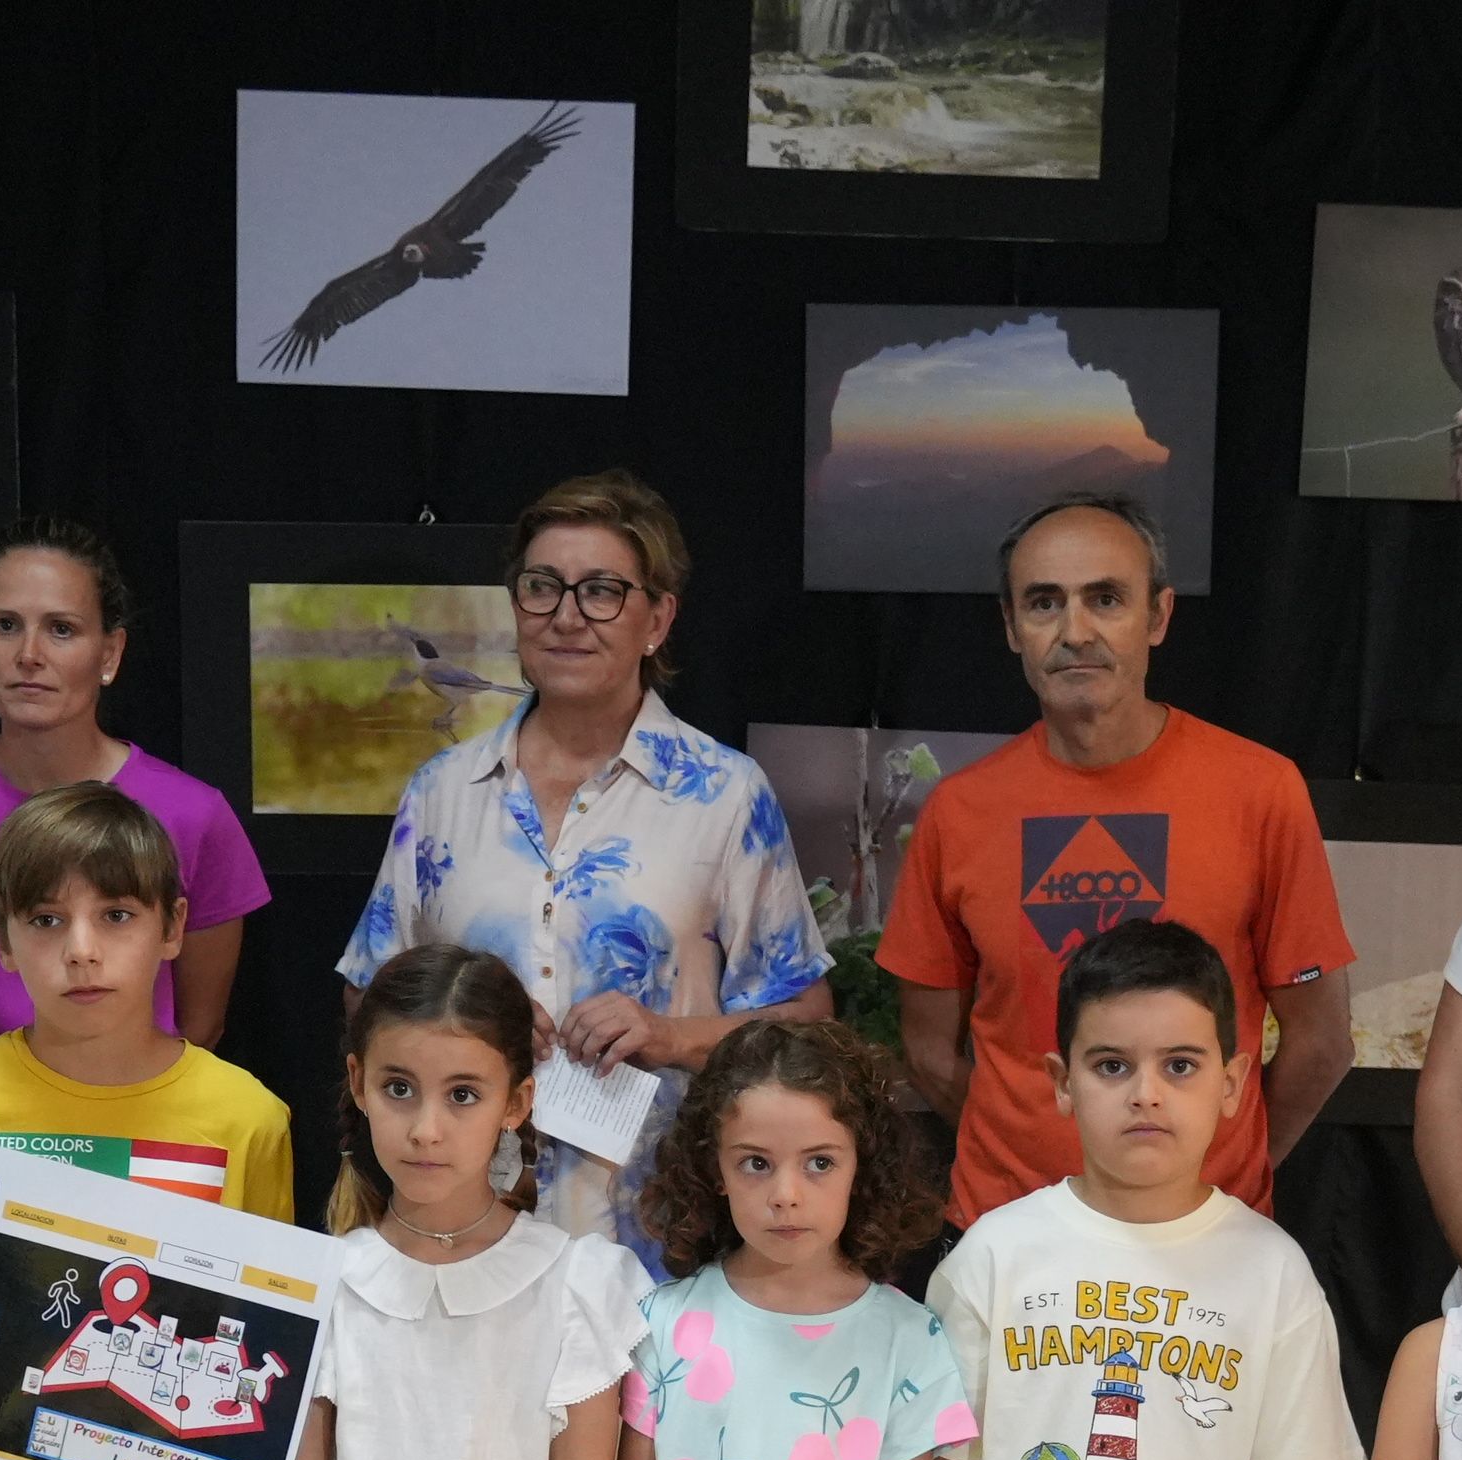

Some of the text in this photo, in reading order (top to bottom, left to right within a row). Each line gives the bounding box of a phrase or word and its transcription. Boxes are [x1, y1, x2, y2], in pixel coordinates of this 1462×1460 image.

[30, 1137, 94, 1153] COLORS
[1024, 1280, 1227, 1328] EST. BEST 1975
[72, 1422, 133, 1448] Proyecto
